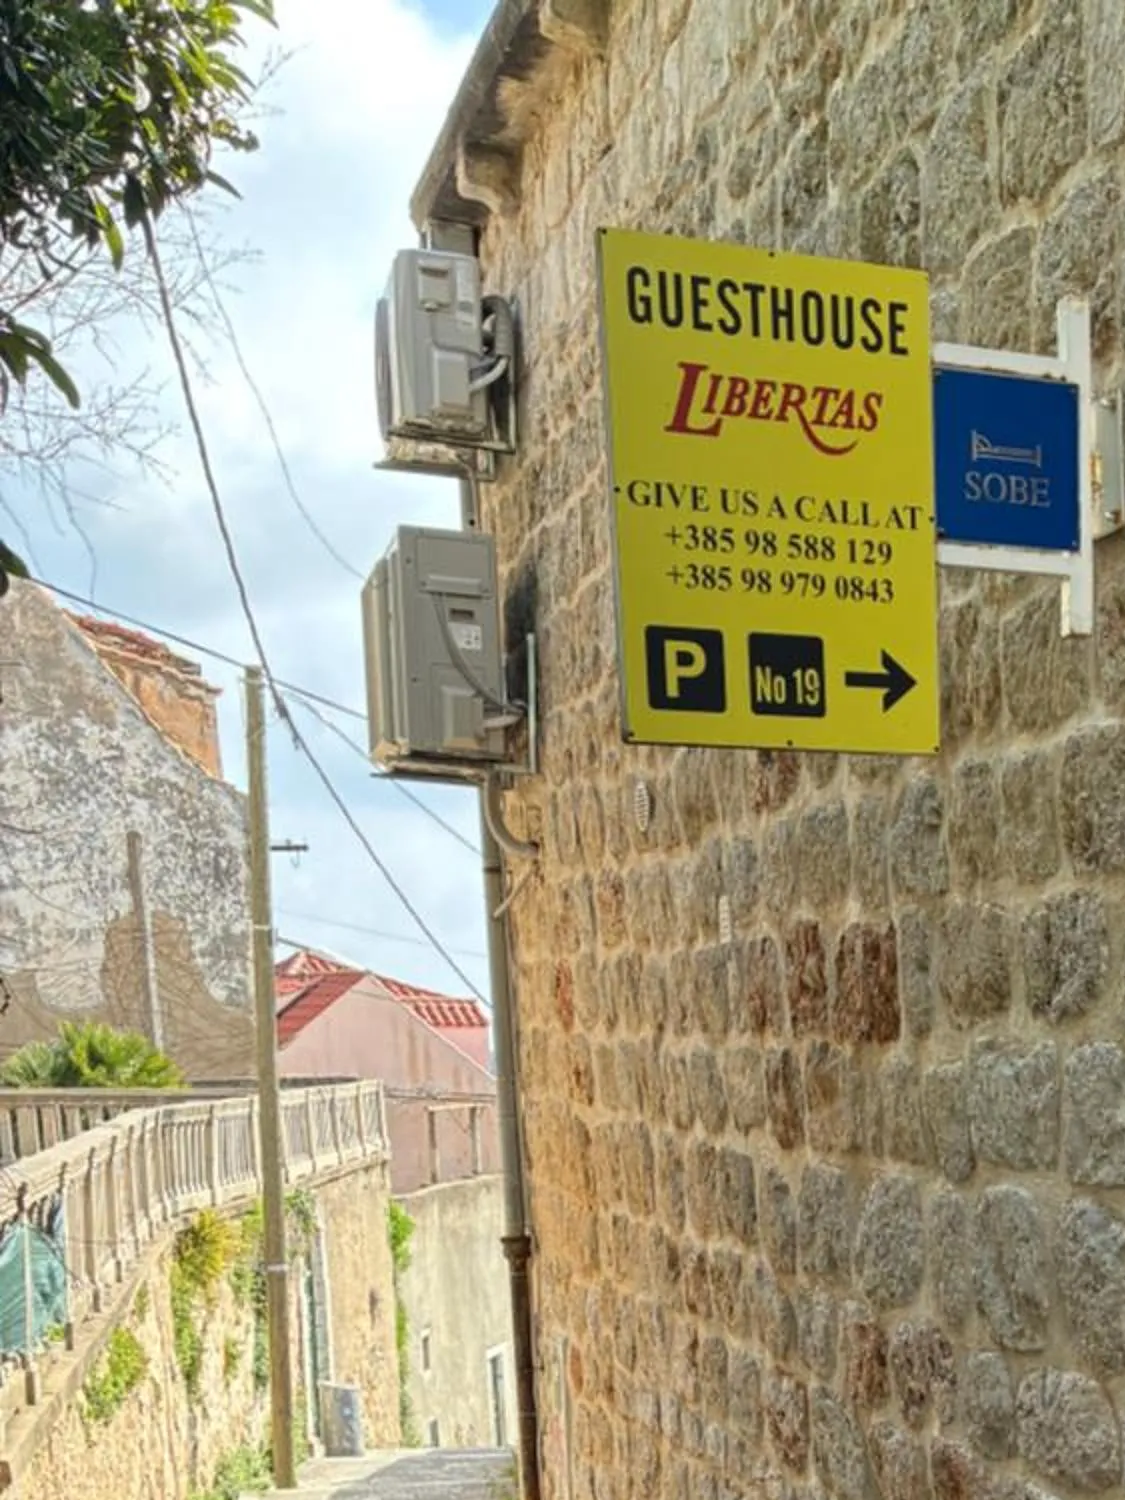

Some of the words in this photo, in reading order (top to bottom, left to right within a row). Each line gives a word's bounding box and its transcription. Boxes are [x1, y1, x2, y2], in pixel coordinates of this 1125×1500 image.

[627, 266, 908, 356] GUESTHOUSE
[664, 361, 883, 456] LIBERTAS
[627, 479, 709, 513] GIVE
[720, 488, 759, 518] US
[767, 495, 787, 519] A
[795, 496, 880, 529] CALL
[884, 506, 922, 530] AT
[963, 470, 1051, 508] SOBE
[665, 524, 735, 554] +385
[745, 530, 777, 557] 98
[788, 534, 836, 562] 588
[847, 538, 893, 565] 129
[666, 564, 733, 592] +385
[741, 568, 772, 595] 98
[781, 573, 826, 599] 979
[835, 576, 894, 604] 0843
[664, 639, 707, 698] P
[755, 666, 786, 705] No
[795, 668, 821, 706] 19
